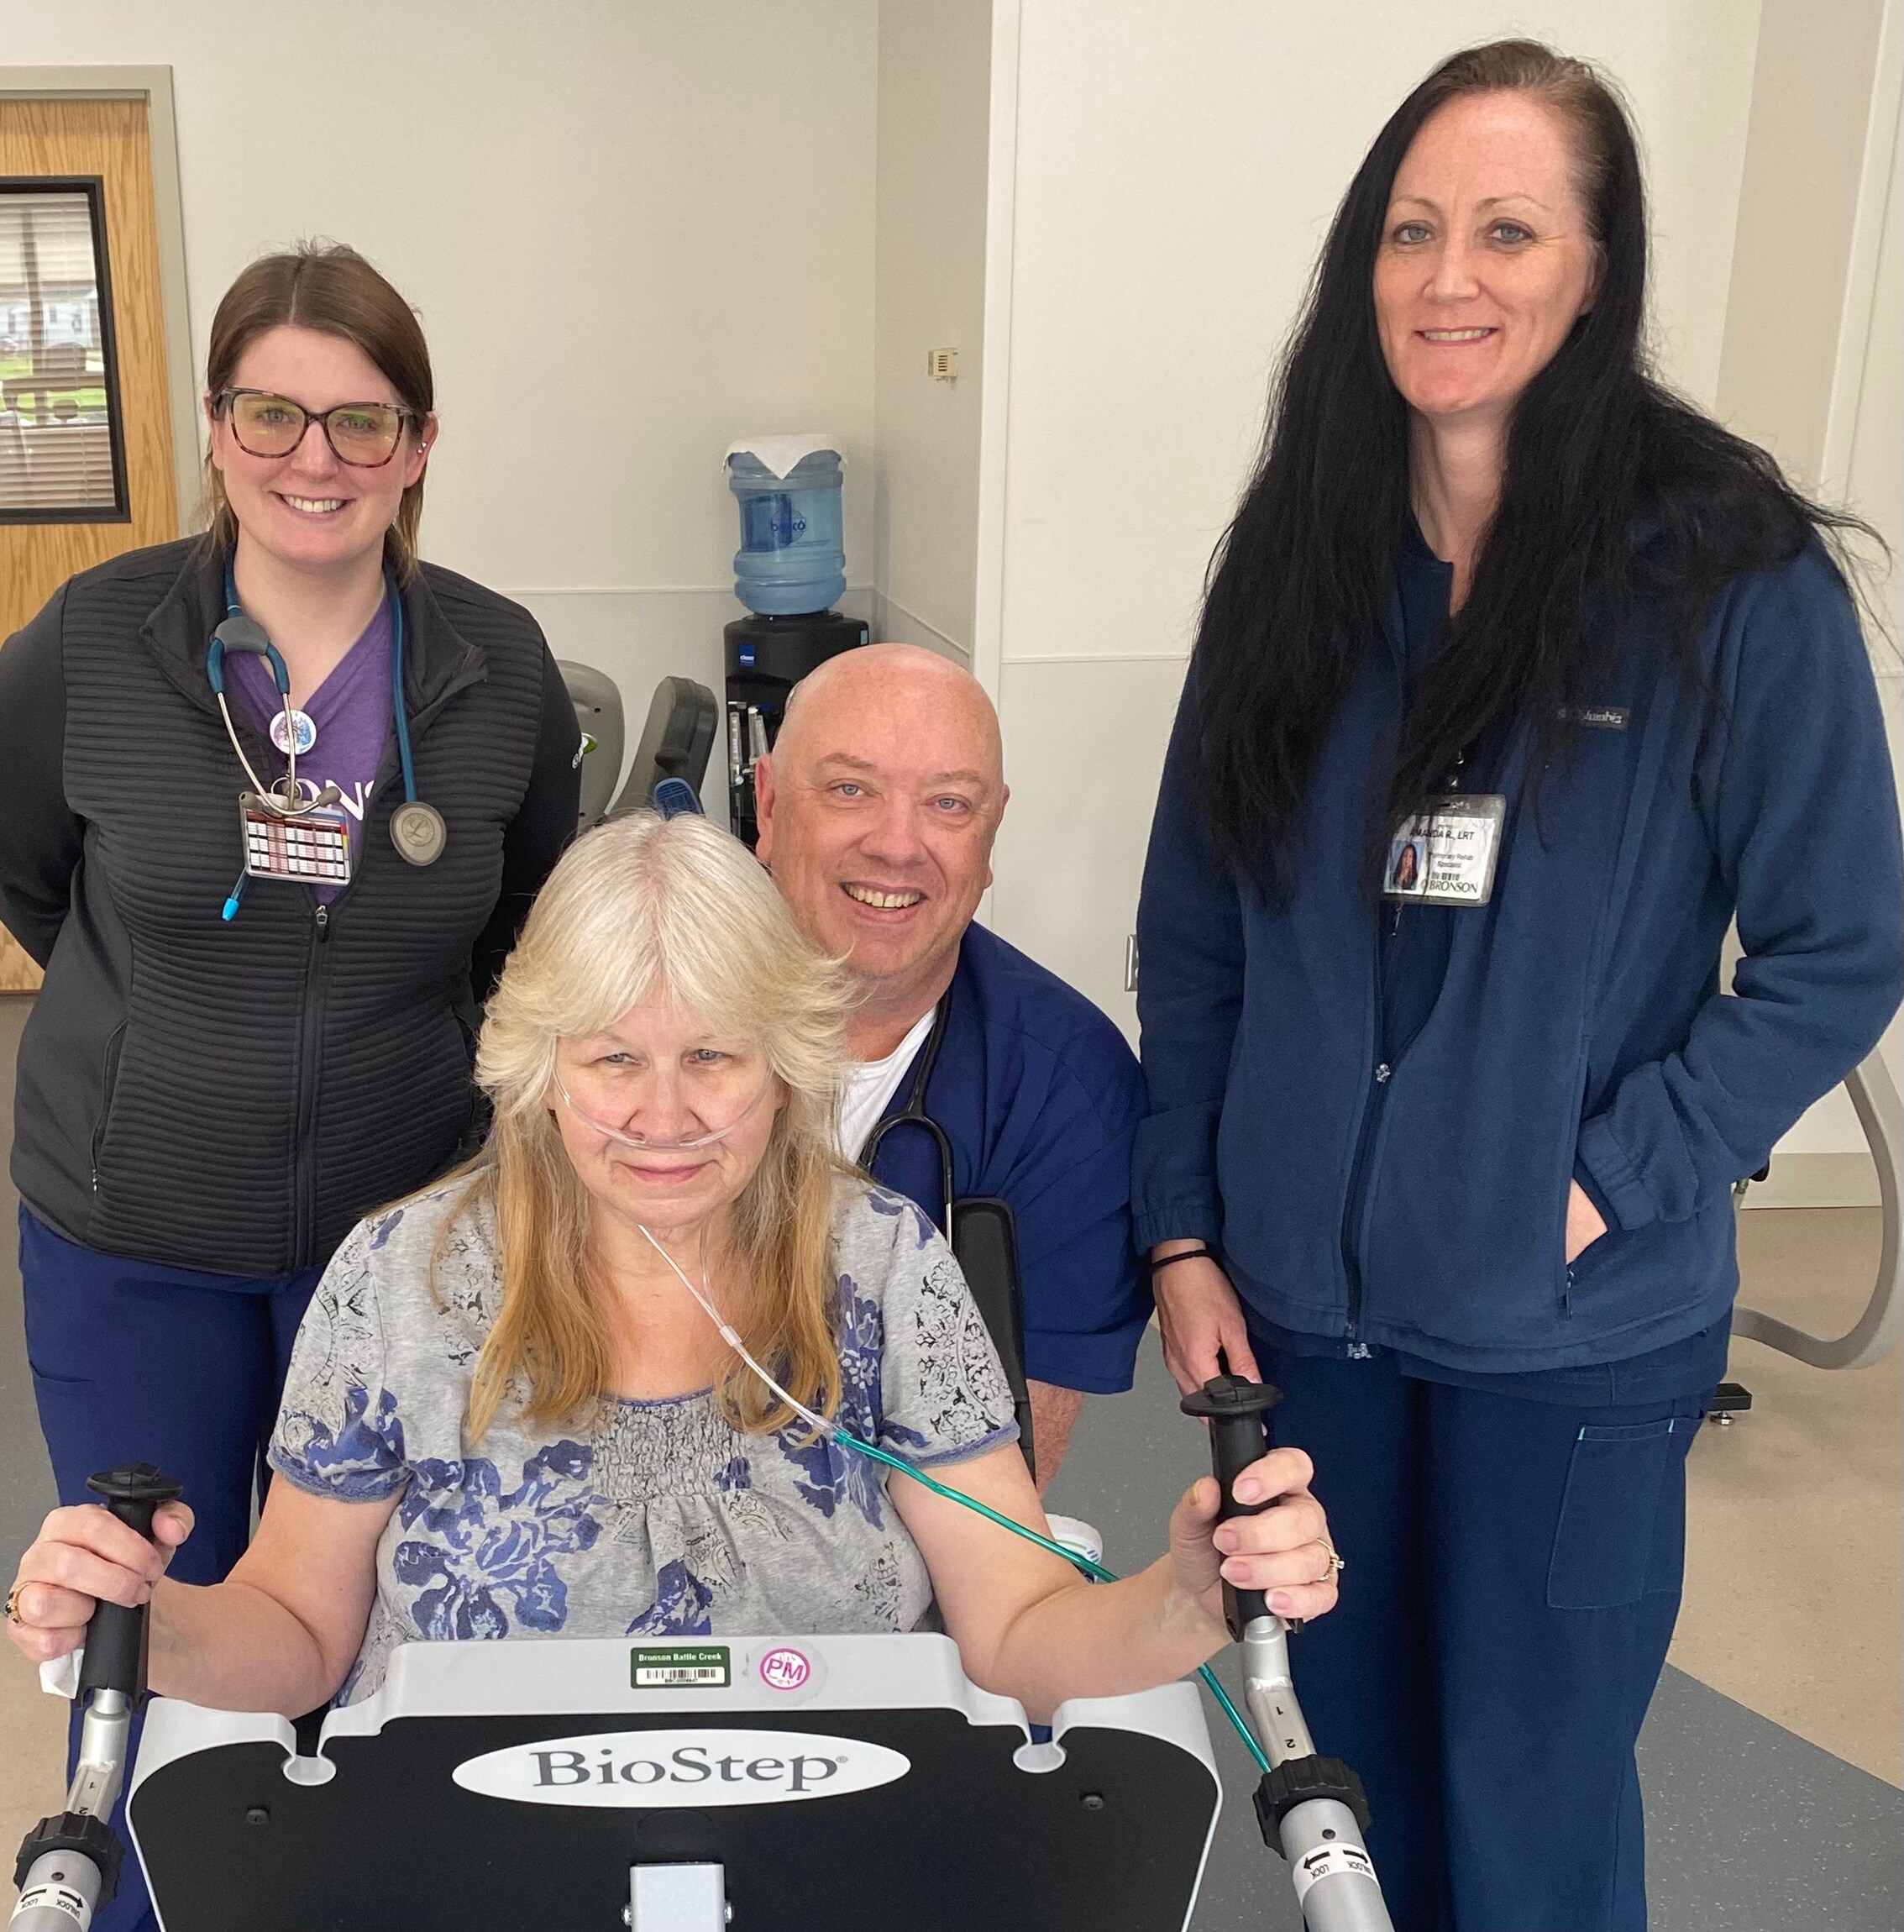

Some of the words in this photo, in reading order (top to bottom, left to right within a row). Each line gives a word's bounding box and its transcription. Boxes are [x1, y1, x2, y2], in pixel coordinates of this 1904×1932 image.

[1457, 831, 1475, 840] LRT
[1429, 879, 1478, 894] BRONSON
[638, 1653, 672, 1662] Bronson
[698, 1652, 722, 1661] Creek
[766, 1658, 804, 1681] PM
[1276, 1705, 1284, 1716] 1
[1284, 1738, 1297, 1749] 2
[88, 1781, 97, 1790] 1
[78, 1806, 89, 1815] 2
[1310, 1863, 1330, 1881] LOCK
[19, 1898, 39, 1911] LOCK
[55, 1898, 81, 1920] UNLOCK
